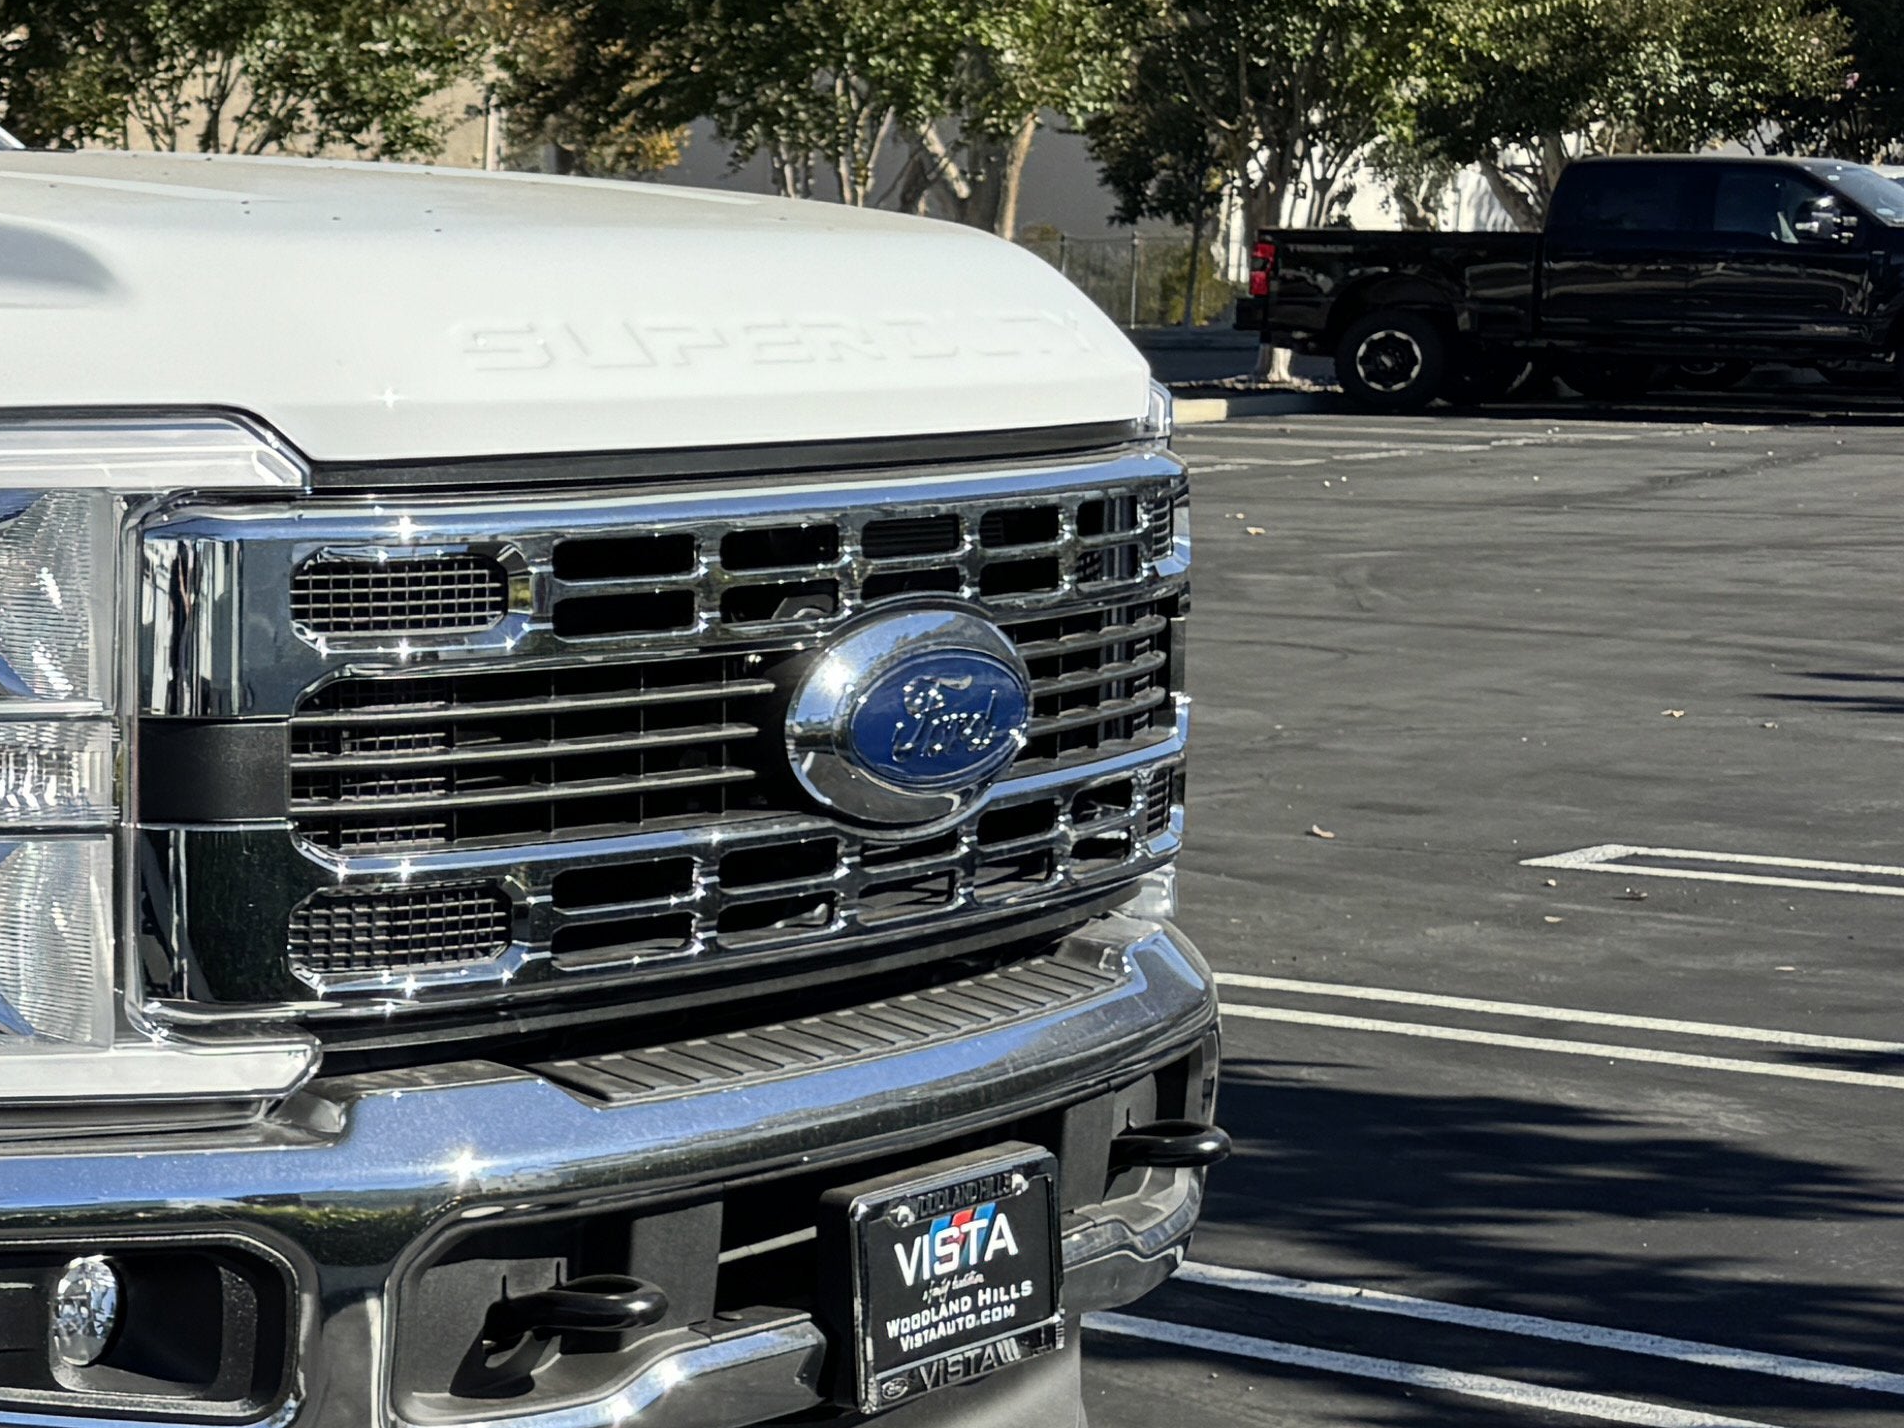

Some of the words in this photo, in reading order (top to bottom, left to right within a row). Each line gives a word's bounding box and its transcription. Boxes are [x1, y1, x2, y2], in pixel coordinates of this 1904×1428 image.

[891, 674, 998, 763] Ford
[893, 1212, 1019, 1287] VISTA
[886, 1295, 972, 1339] WOODLAND
[977, 1280, 1034, 1307] HILLS
[919, 1345, 999, 1392] VISTA
